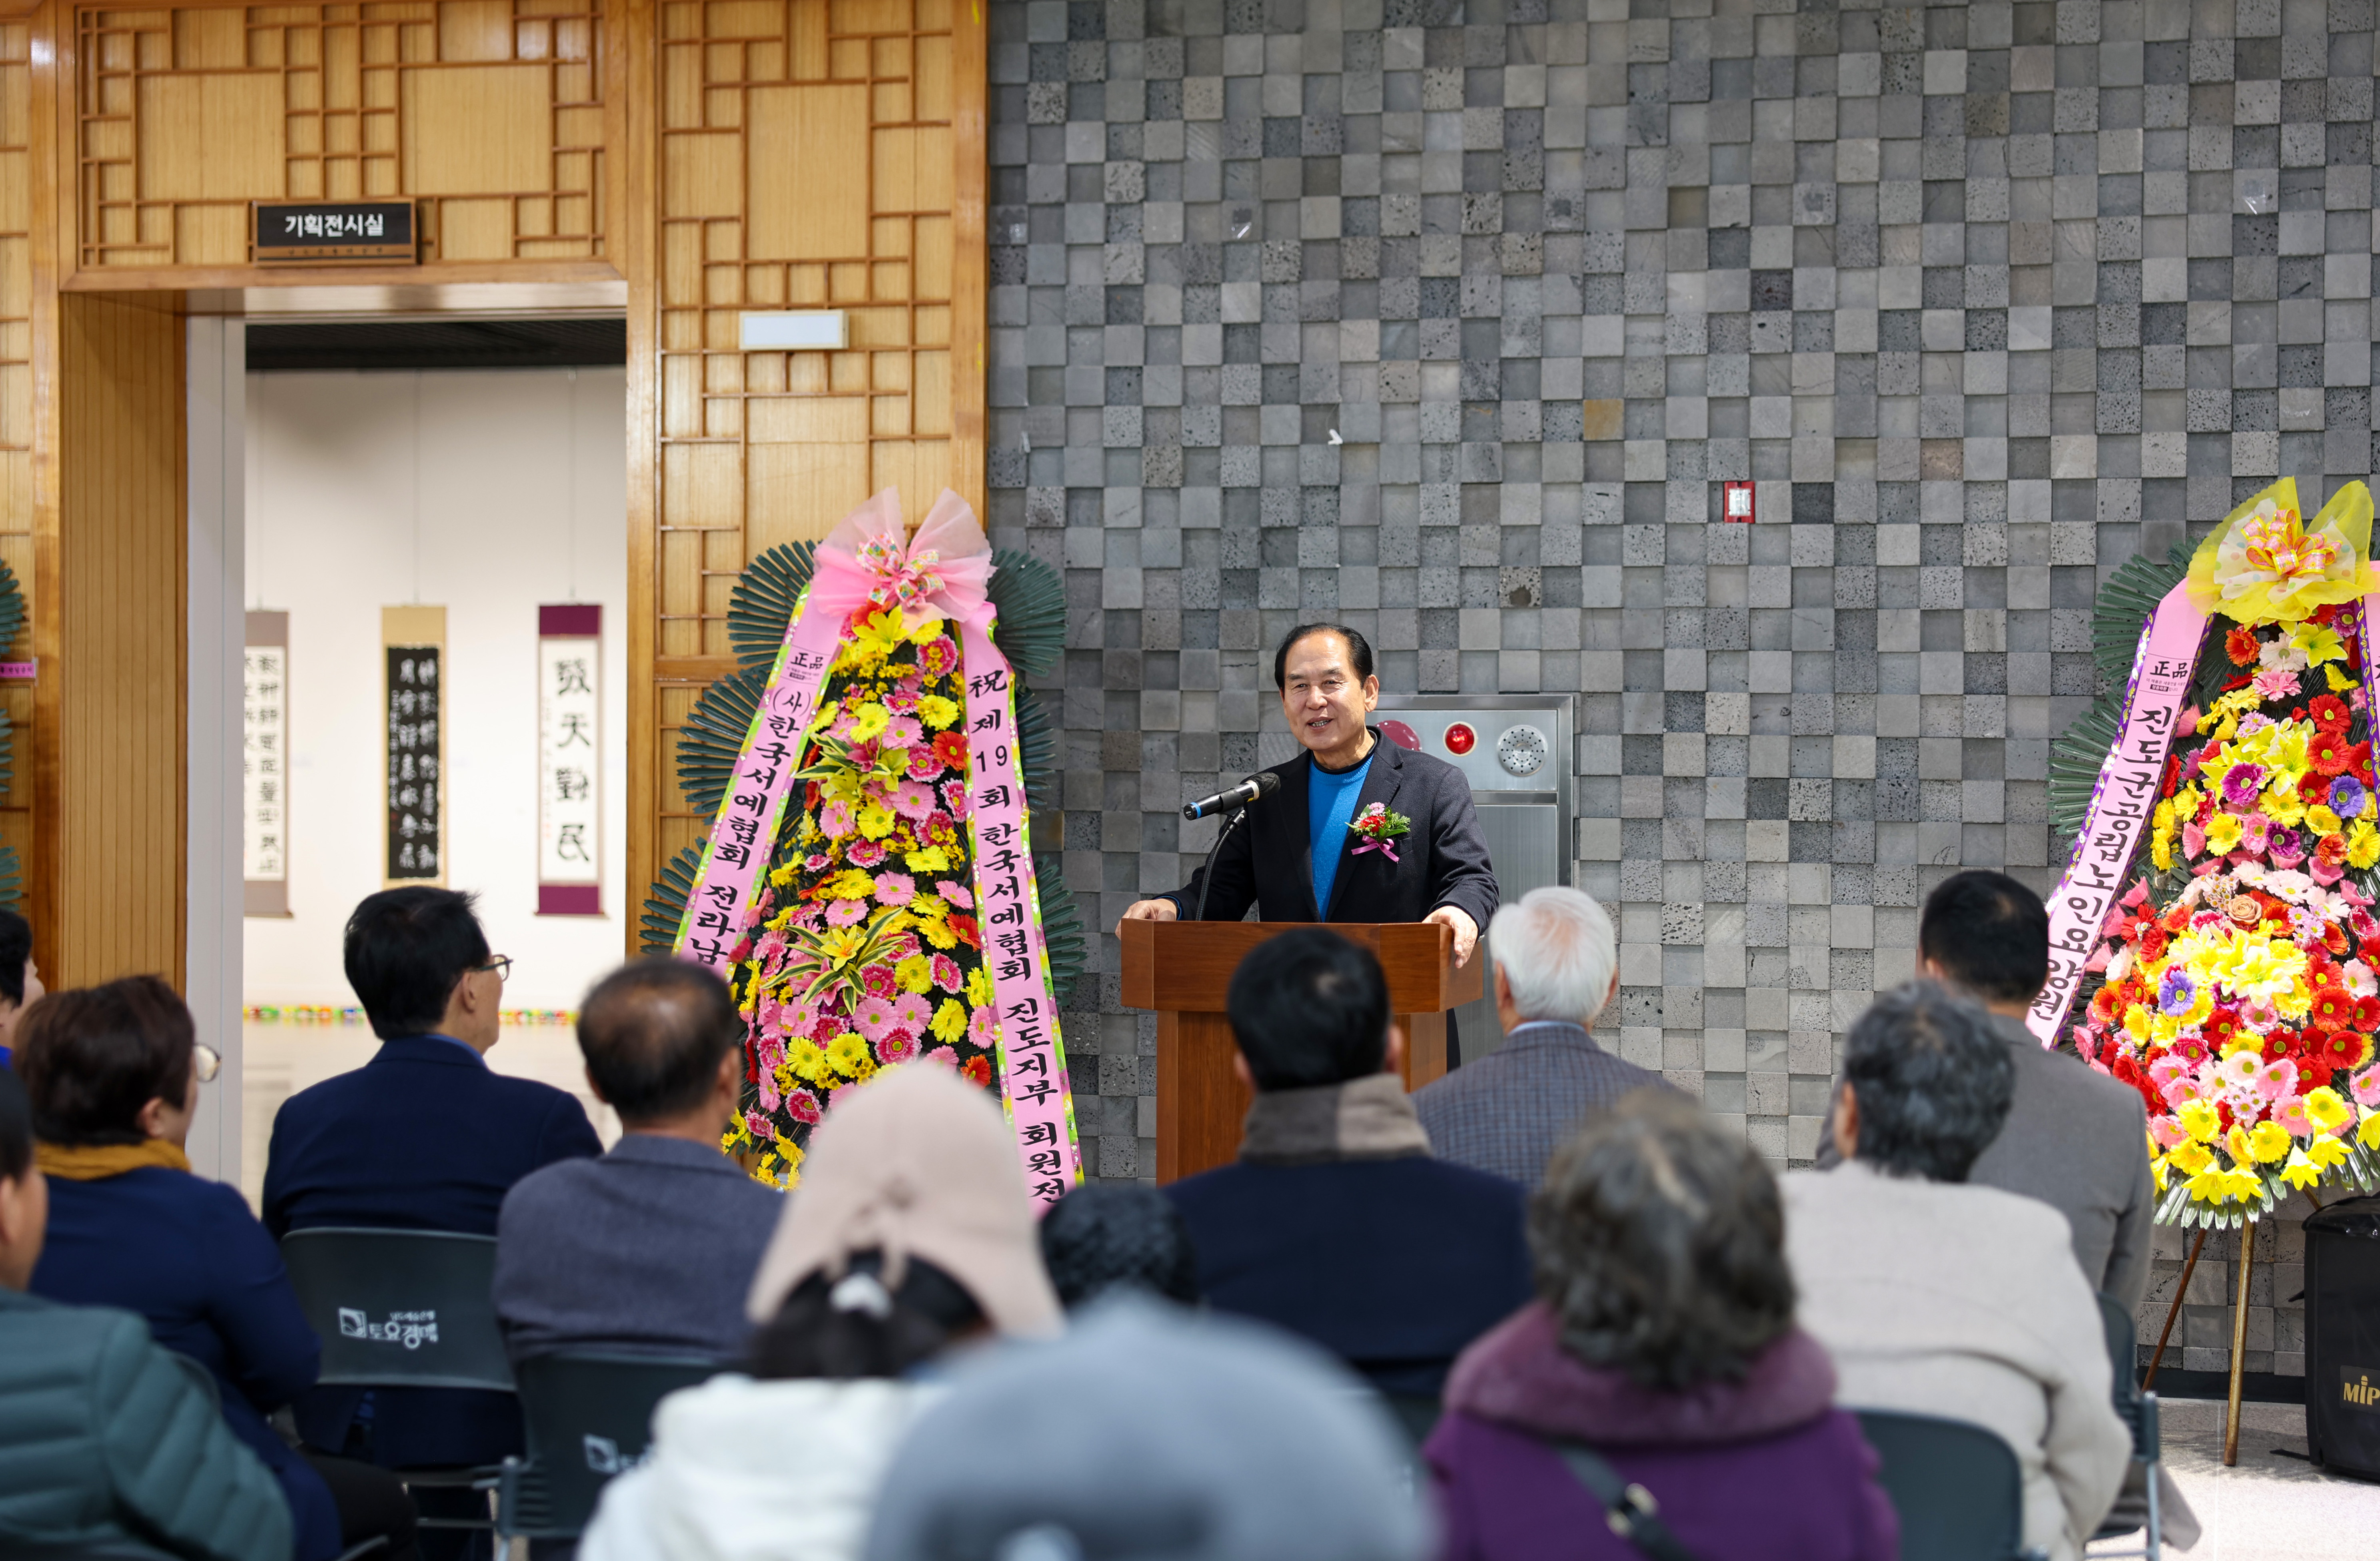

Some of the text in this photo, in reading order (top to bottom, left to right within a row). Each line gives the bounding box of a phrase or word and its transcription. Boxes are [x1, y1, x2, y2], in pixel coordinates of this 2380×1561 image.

[285, 213, 384, 238] 기획전시실
[791, 653, 823, 670] 正品
[2150, 661, 2188, 679] 正品
[980, 823, 1031, 981] 한국서예협회
[1003, 998, 1058, 1107] 진도지부
[1020, 1122, 1065, 1204] 회원전
